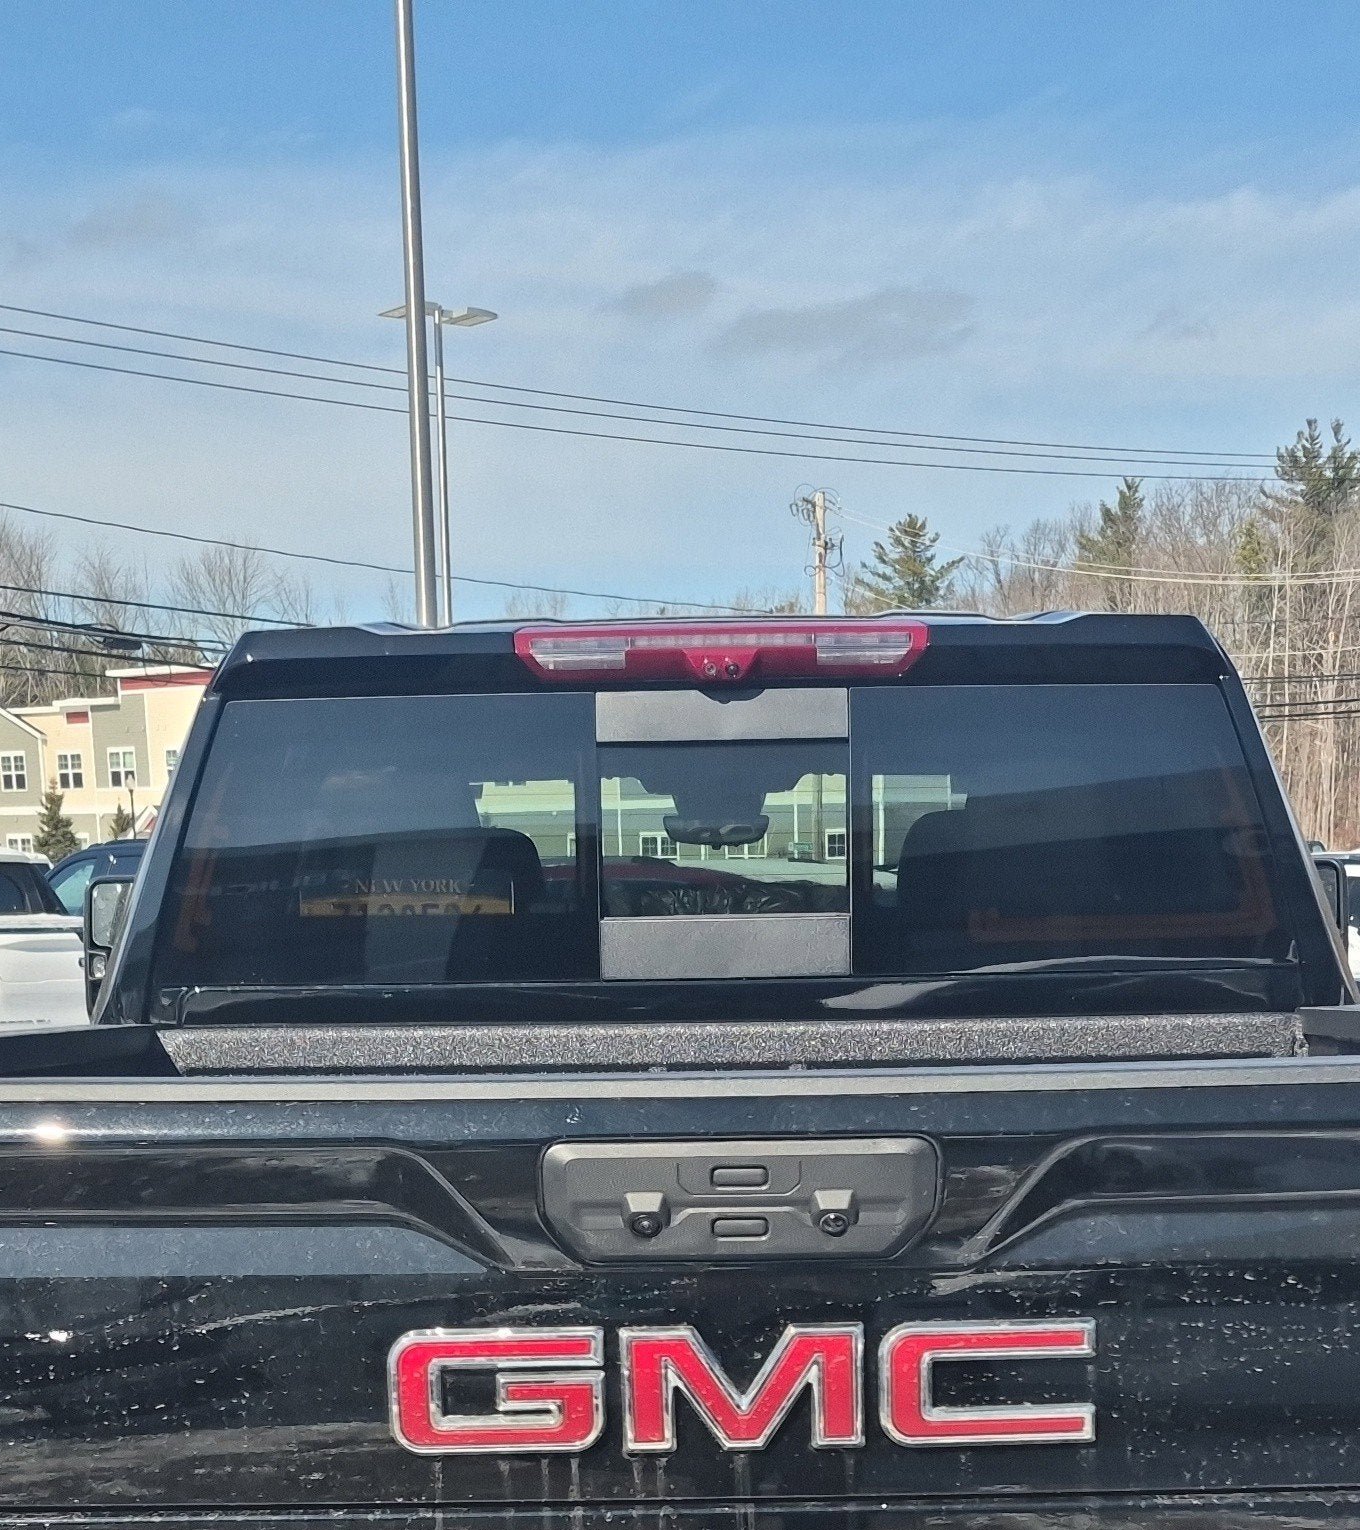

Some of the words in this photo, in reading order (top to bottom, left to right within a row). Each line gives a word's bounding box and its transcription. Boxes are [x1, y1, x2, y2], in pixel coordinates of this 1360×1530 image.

[354, 878, 403, 894] NEW
[410, 878, 462, 894] YORK
[388, 1318, 1098, 1456] GMC
